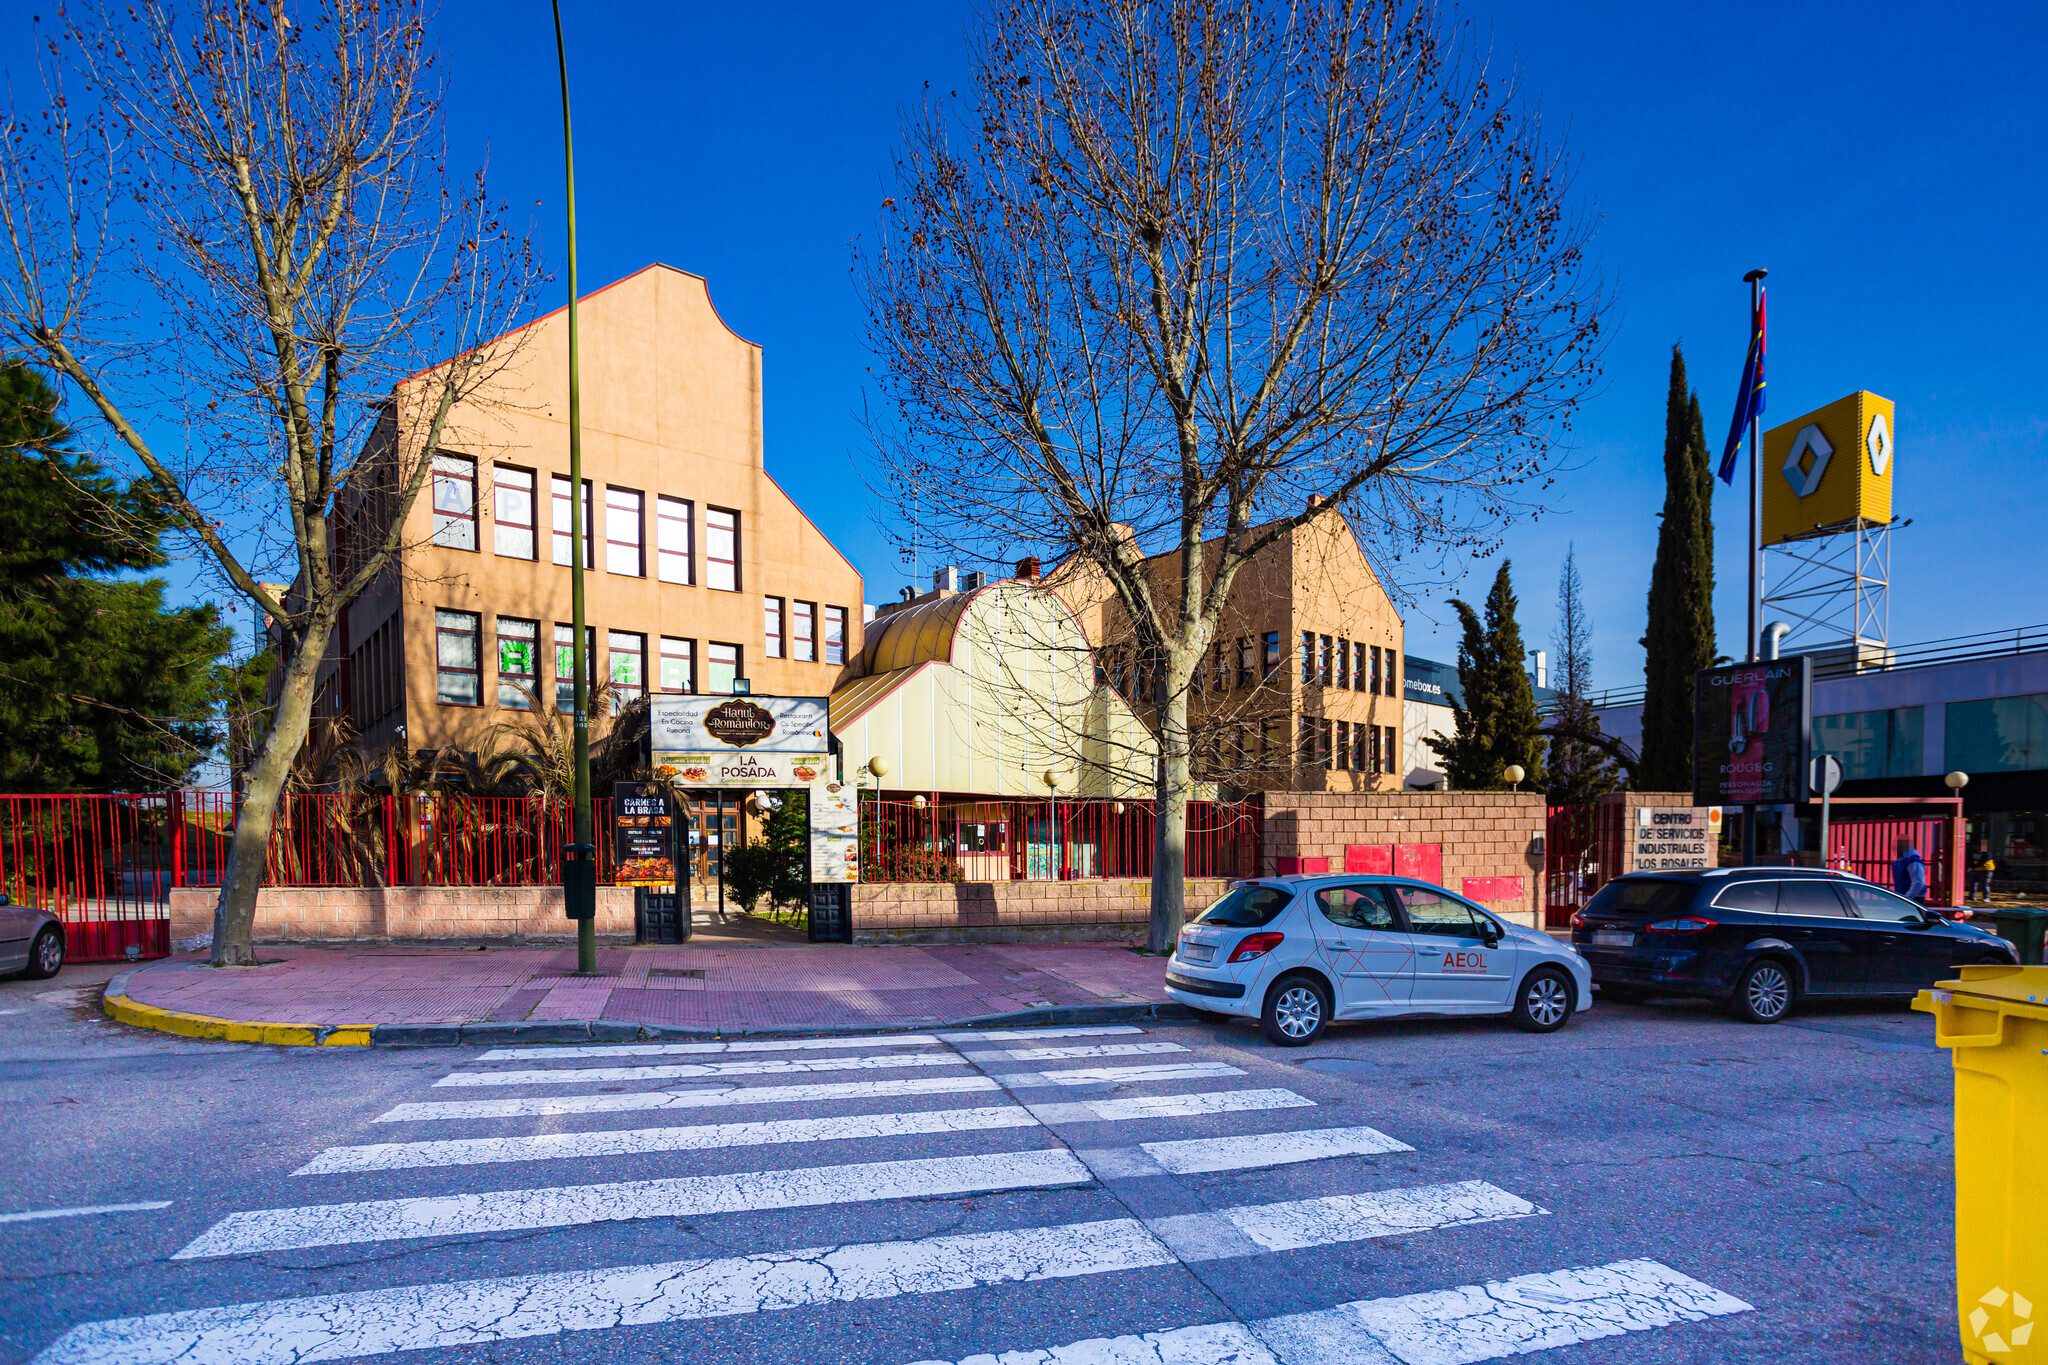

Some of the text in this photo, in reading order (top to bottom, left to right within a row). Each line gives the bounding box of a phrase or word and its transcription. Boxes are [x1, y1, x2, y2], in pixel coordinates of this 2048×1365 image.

[1711, 668, 1791, 686] GUERLAIN
[658, 710, 698, 718] Especialidad
[720, 707, 755, 719] Hanul
[739, 755, 757, 766] LA
[721, 767, 777, 778] POSADA
[624, 798, 665, 806] CARNES A
[624, 806, 665, 815] LA BRASA
[1653, 813, 1692, 825] CENTRO
[1639, 828, 1705, 839] DE SERVICIOS
[1638, 843, 1705, 854] INDUSTRIALES
